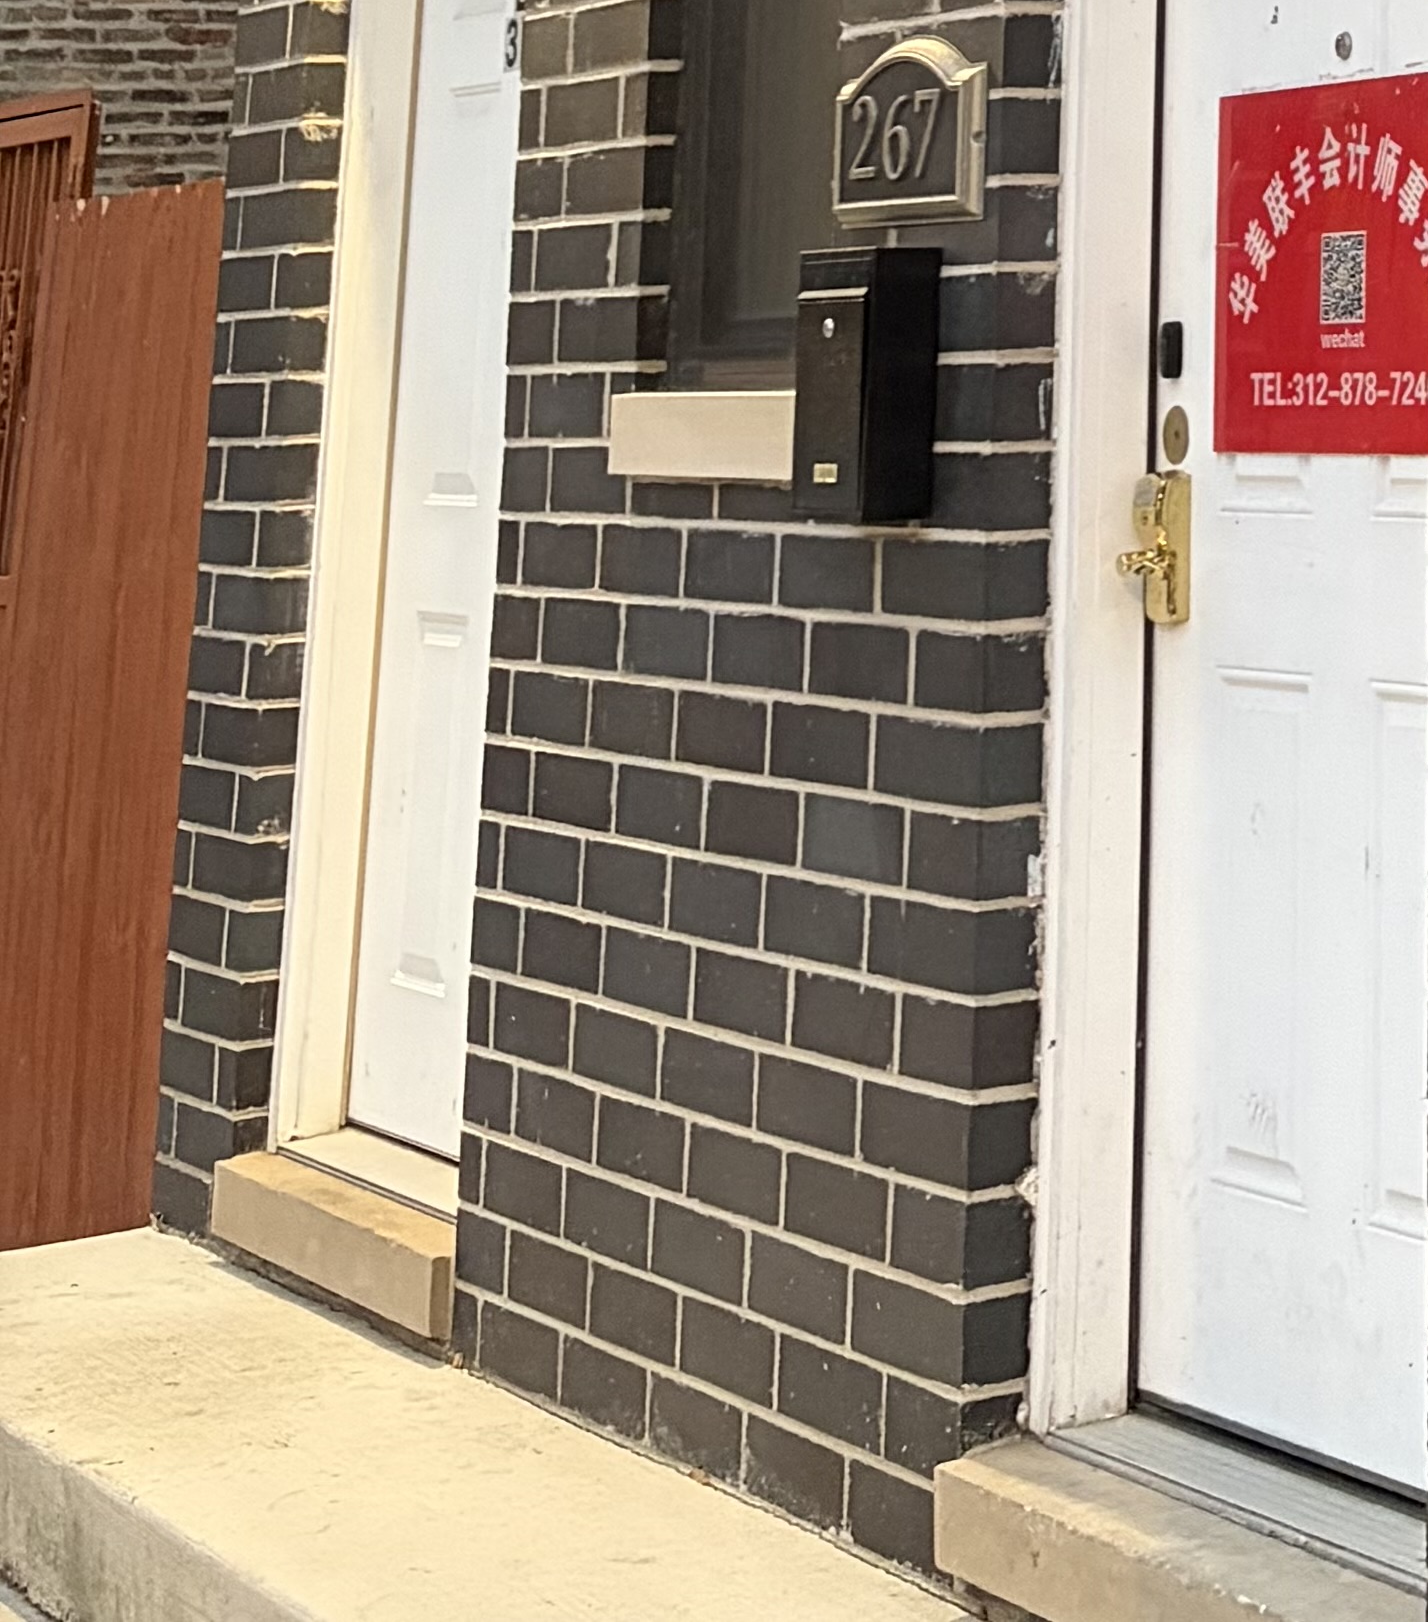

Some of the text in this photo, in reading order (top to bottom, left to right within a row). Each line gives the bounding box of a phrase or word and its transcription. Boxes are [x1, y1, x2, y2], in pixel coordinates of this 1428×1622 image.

[505, 19, 518, 68] 3
[848, 89, 940, 180] 267
[1320, 329, 1365, 349] wechat
